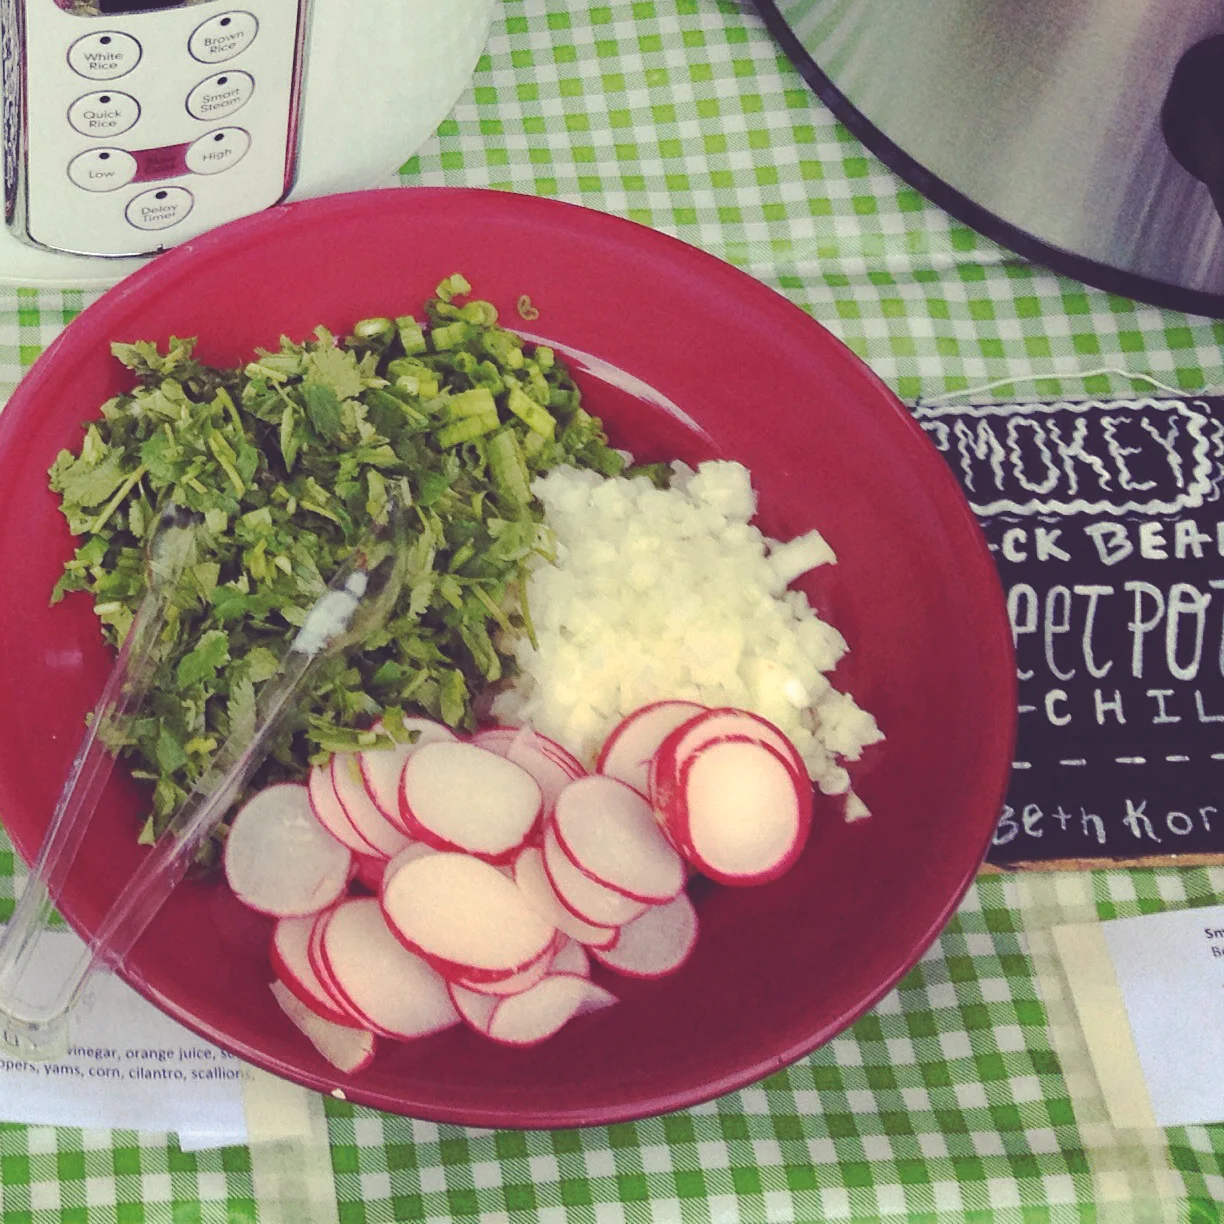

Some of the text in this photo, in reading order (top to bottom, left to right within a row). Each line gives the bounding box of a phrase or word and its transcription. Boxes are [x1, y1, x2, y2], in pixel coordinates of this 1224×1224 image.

[204, 31, 245, 46] Brown
[209, 42, 236, 54] Rice
[84, 52, 124, 62] White
[89, 62, 118, 70] Rice
[202, 88, 240, 103] Smart
[200, 97, 241, 113] Steam
[83, 109, 122, 120] Quick
[89, 119, 118, 128] Rice
[202, 149, 232, 163] High
[88, 170, 116, 179] Low
[141, 204, 178, 216] Delay
[143, 212, 177, 223] Timer
[987, 519, 1224, 566] CK BEA
[126, 1048, 174, 1061] orange
[178, 1046, 216, 1061] juice,
[44, 1063, 84, 1077] yams,
[88, 1067, 124, 1080] corn,
[128, 1066, 187, 1080] cilantro,
